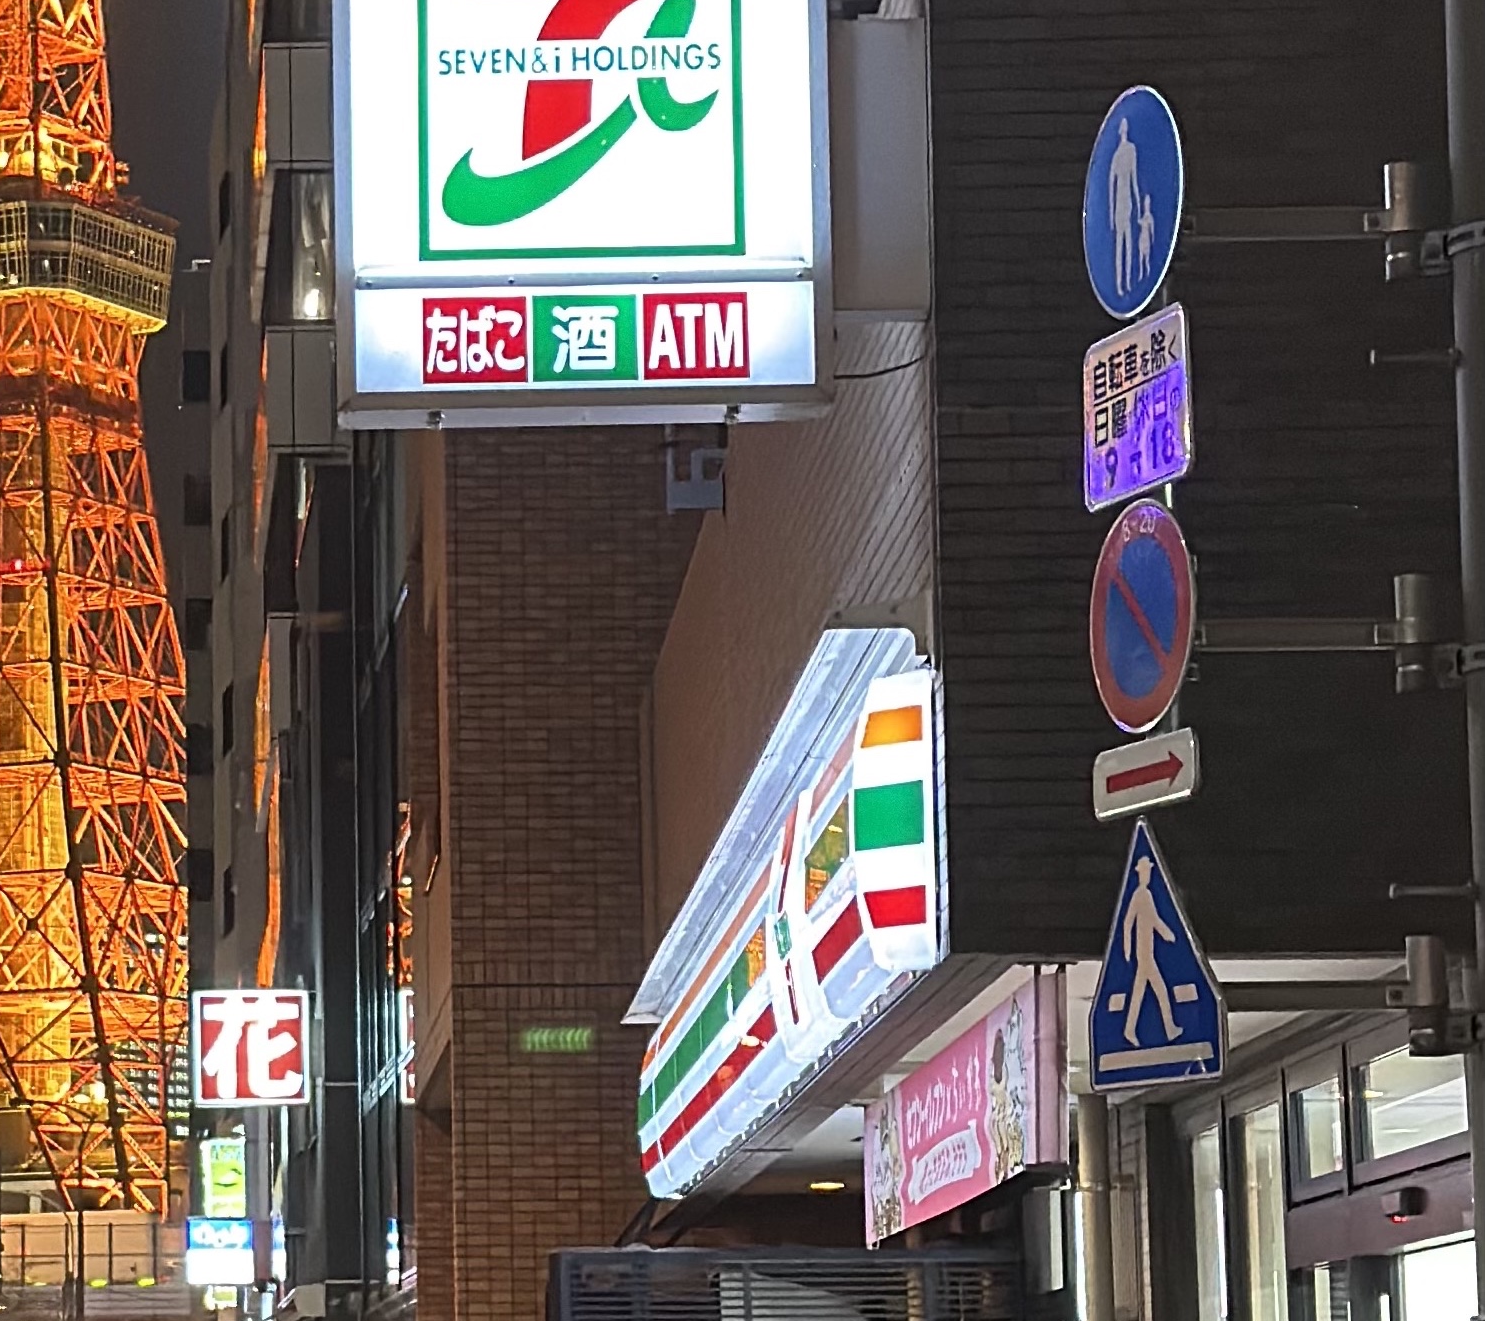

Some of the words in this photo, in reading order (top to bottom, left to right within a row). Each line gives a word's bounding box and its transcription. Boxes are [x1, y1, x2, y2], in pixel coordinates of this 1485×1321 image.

[571, 41, 722, 74] HOLDINGS
[425, 304, 526, 375] たばこ
[551, 304, 620, 374] 酒
[647, 301, 745, 370] ATM
[1093, 329, 1178, 402] 自転車を除く
[201, 993, 303, 1099] 花
